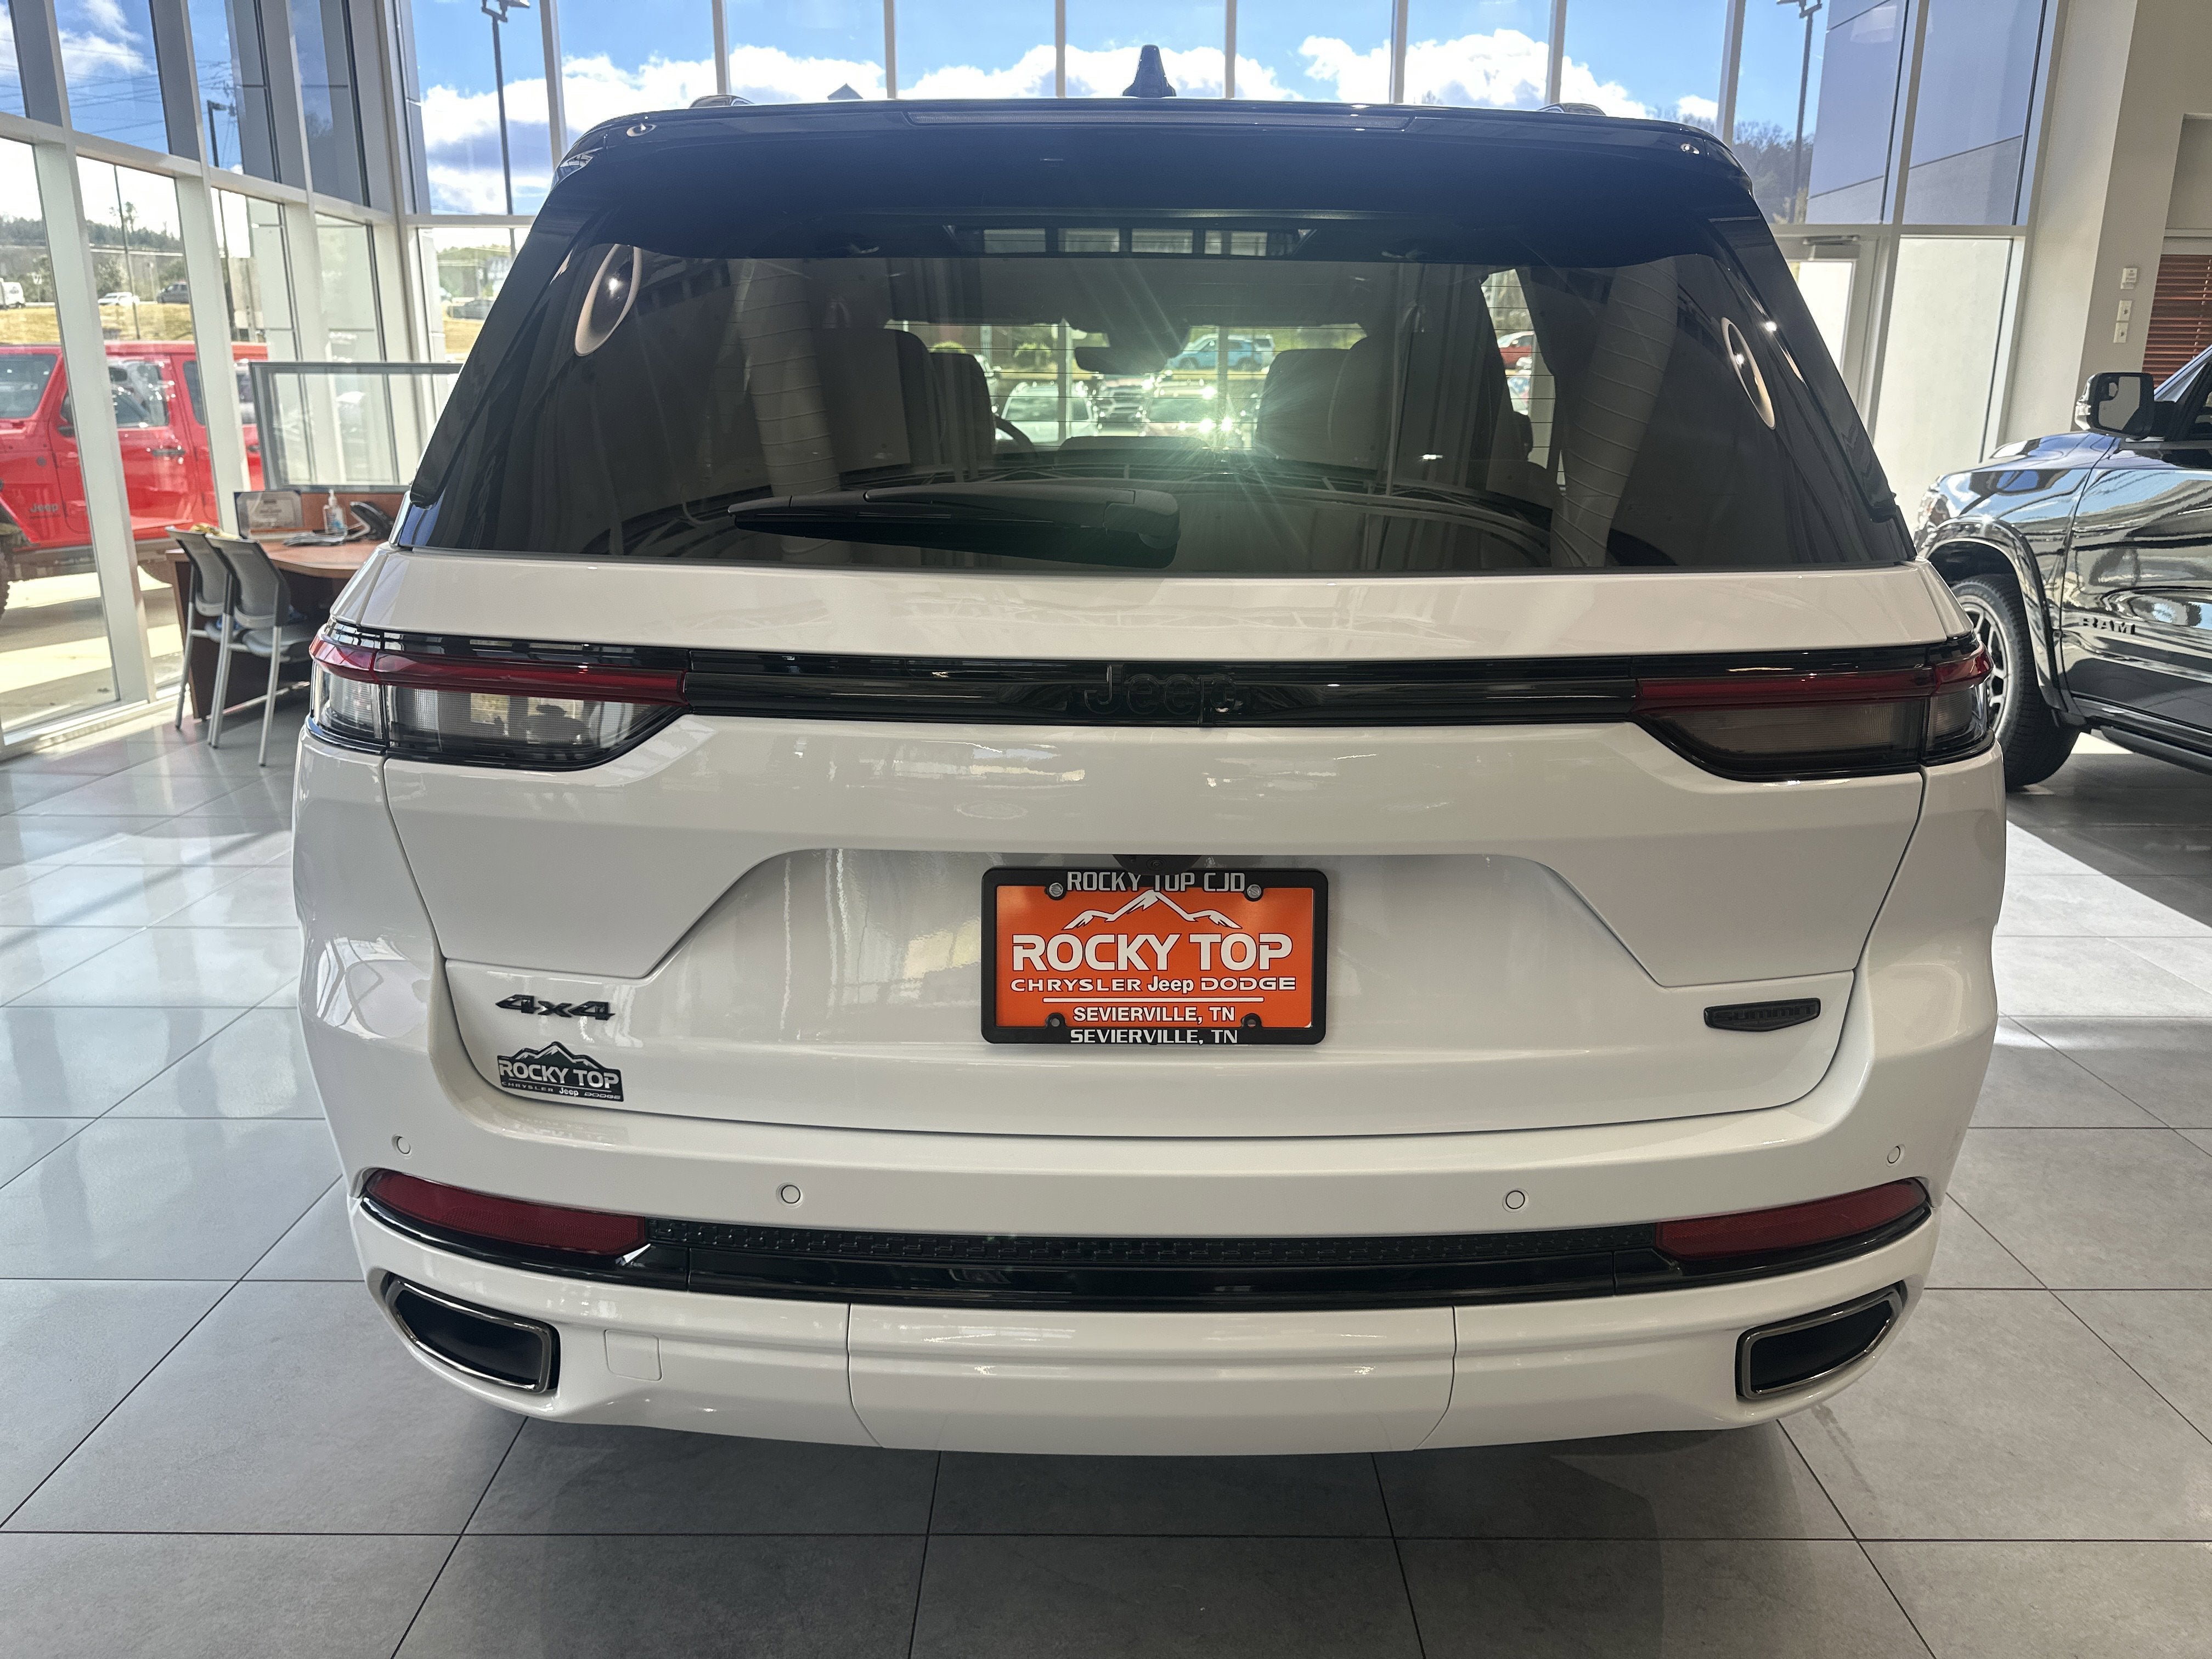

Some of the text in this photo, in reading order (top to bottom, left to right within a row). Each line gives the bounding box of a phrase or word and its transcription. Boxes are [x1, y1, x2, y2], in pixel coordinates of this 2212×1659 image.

[2080, 617, 2135, 634] RAM
[1084, 664, 1237, 725] Jeep
[1066, 871, 1142, 891] ROCKY
[1204, 872, 1245, 892] CJD
[1012, 933, 1293, 972] ROCKY TOP
[1010, 975, 1297, 994] CHRYSLER Jeep DODGE
[495, 994, 616, 1021] 4x4
[1073, 1006, 1236, 1025] SEVIERVILLE, TN
[1070, 1029, 1238, 1045] SEVIERVILLE, TN
[498, 1059, 619, 1090] ROCKY TOP
[501, 1081, 622, 1100] CHRYSLER Jeep DODGE
